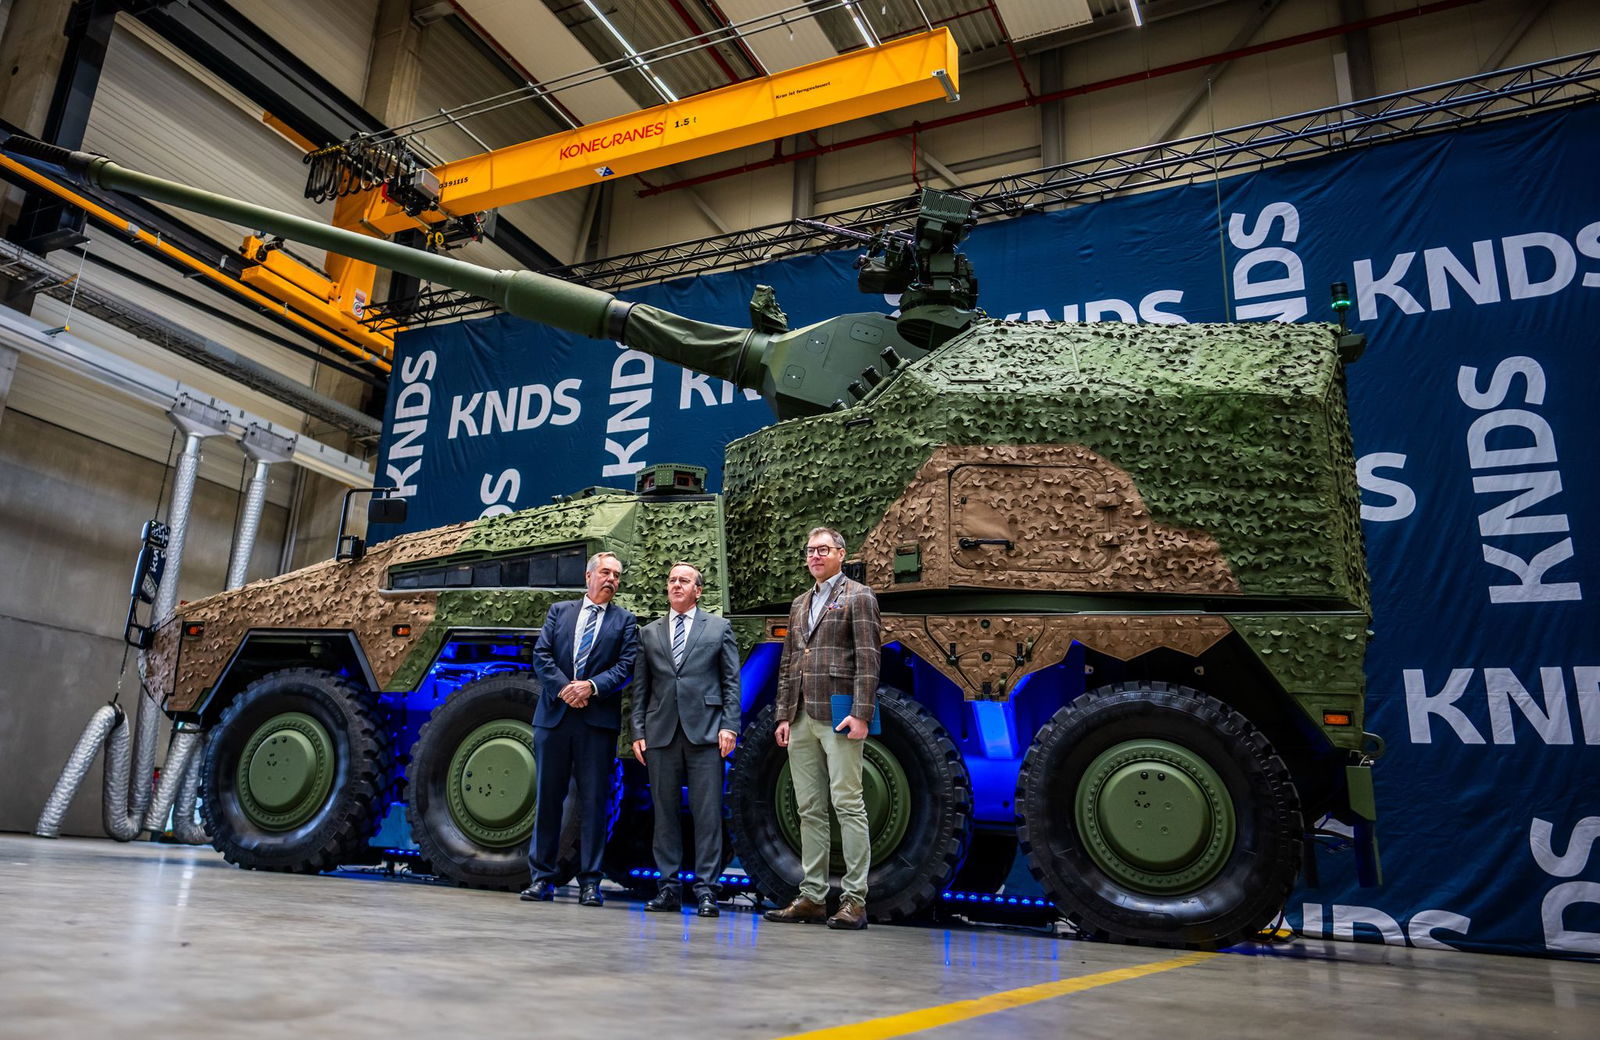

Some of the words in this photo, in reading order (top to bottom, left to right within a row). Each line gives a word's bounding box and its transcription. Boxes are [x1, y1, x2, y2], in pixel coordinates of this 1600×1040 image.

[559, 122, 664, 160] KONECRANES
[674, 117, 690, 128] 1.5
[382, 350, 437, 499] KNDS
[447, 378, 582, 440] KNDS
[602, 341, 655, 477] KND
[1457, 356, 1583, 604] KNDS
